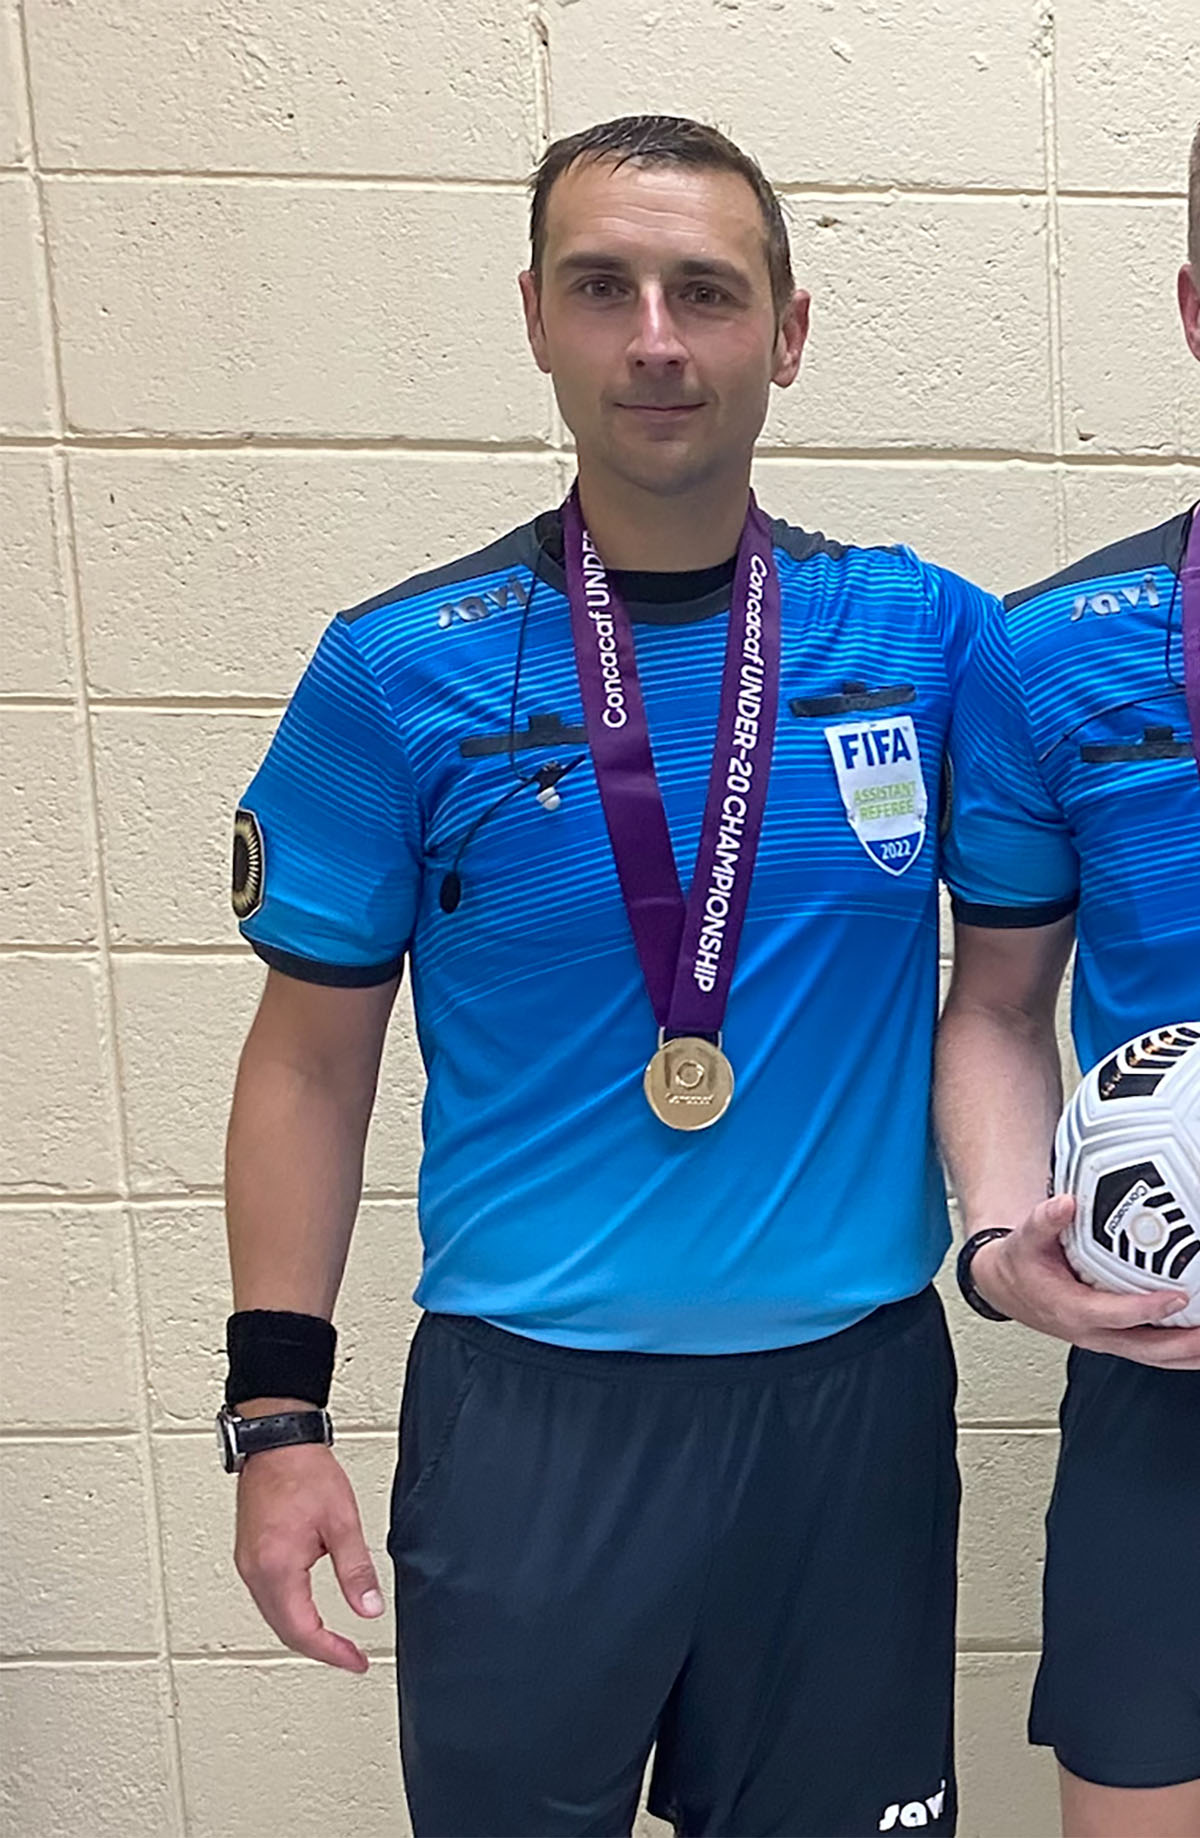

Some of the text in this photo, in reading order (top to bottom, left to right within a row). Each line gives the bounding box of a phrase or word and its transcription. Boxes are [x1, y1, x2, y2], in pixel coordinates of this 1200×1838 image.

[588, 610, 627, 729] Concacaf
[838, 727, 913, 770] FIFA
[693, 554, 768, 993] Concacaf UNDER-20 CHAMPIONSHIP
[853, 780, 917, 804] ASSISTANT
[859, 799, 915, 822] REFEREE
[880, 839, 912, 861] 2022
